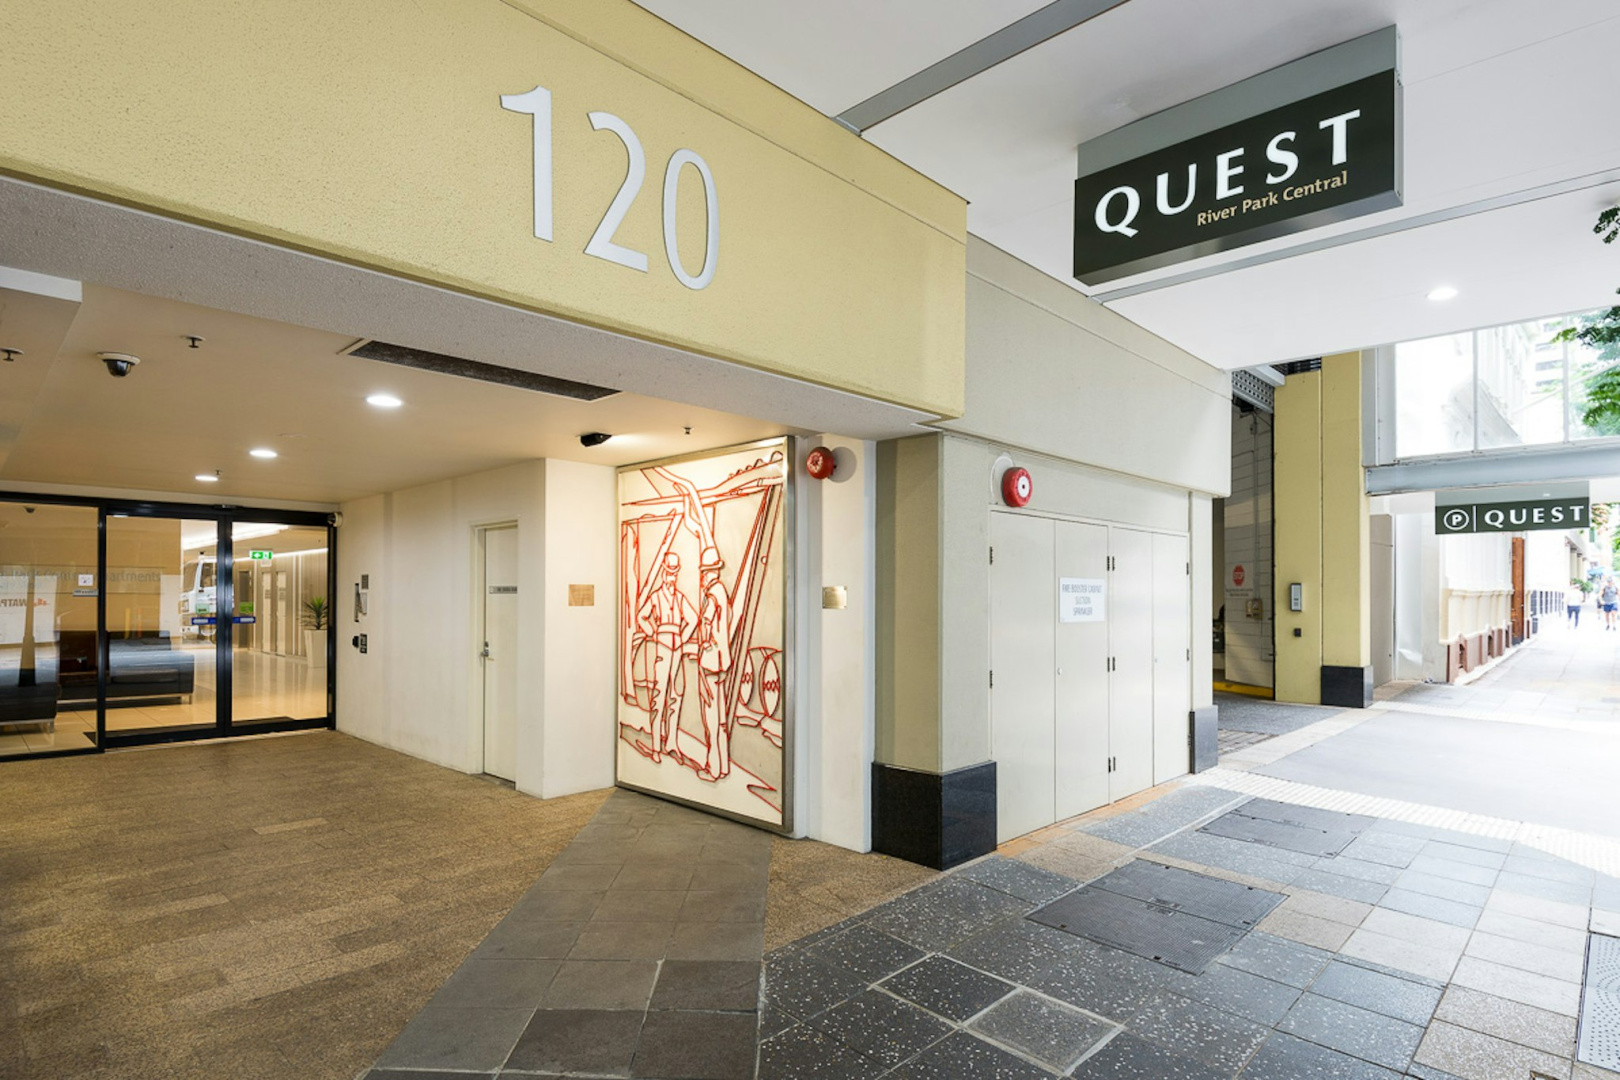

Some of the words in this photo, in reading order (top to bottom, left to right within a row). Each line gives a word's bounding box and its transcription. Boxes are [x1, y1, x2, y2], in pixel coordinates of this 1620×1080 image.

[499, 85, 719, 291] 120
[1094, 109, 1361, 238] QUEST
[1197, 205, 1236, 227] River
[1242, 190, 1278, 214] Park
[1284, 170, 1347, 201] Central
[1484, 505, 1585, 528] QUEST
